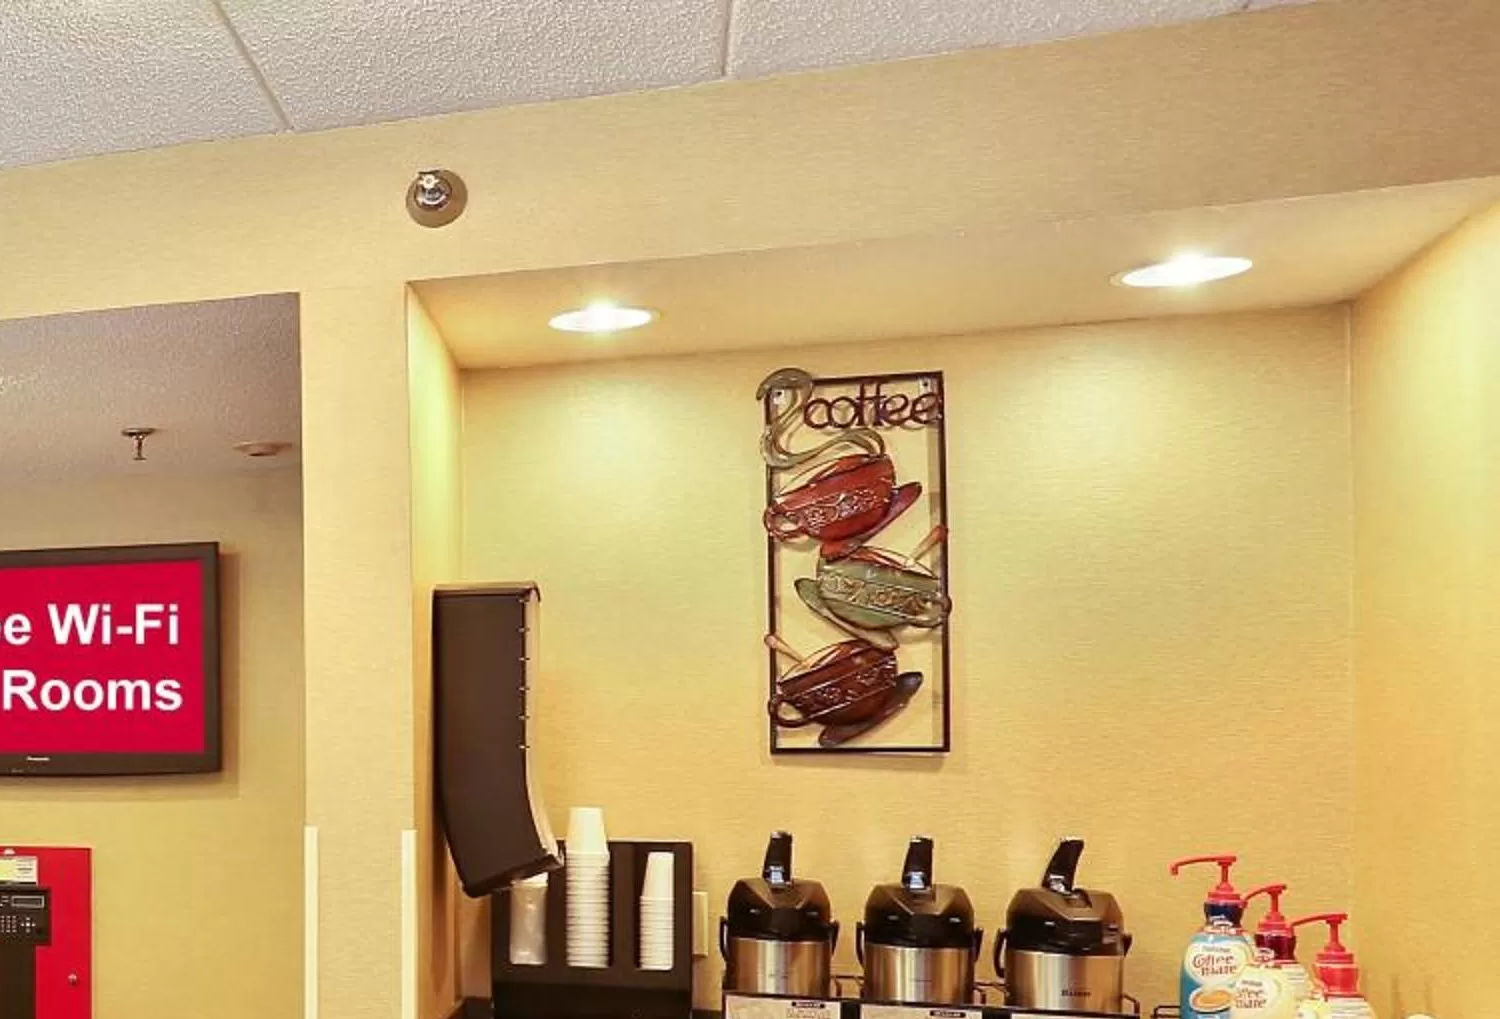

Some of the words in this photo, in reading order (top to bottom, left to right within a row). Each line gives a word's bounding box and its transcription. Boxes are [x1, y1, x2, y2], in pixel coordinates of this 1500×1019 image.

[803, 383, 941, 429] coffee
[47, 603, 180, 645] Wi-Fi
[3, 669, 183, 711] Rooms
